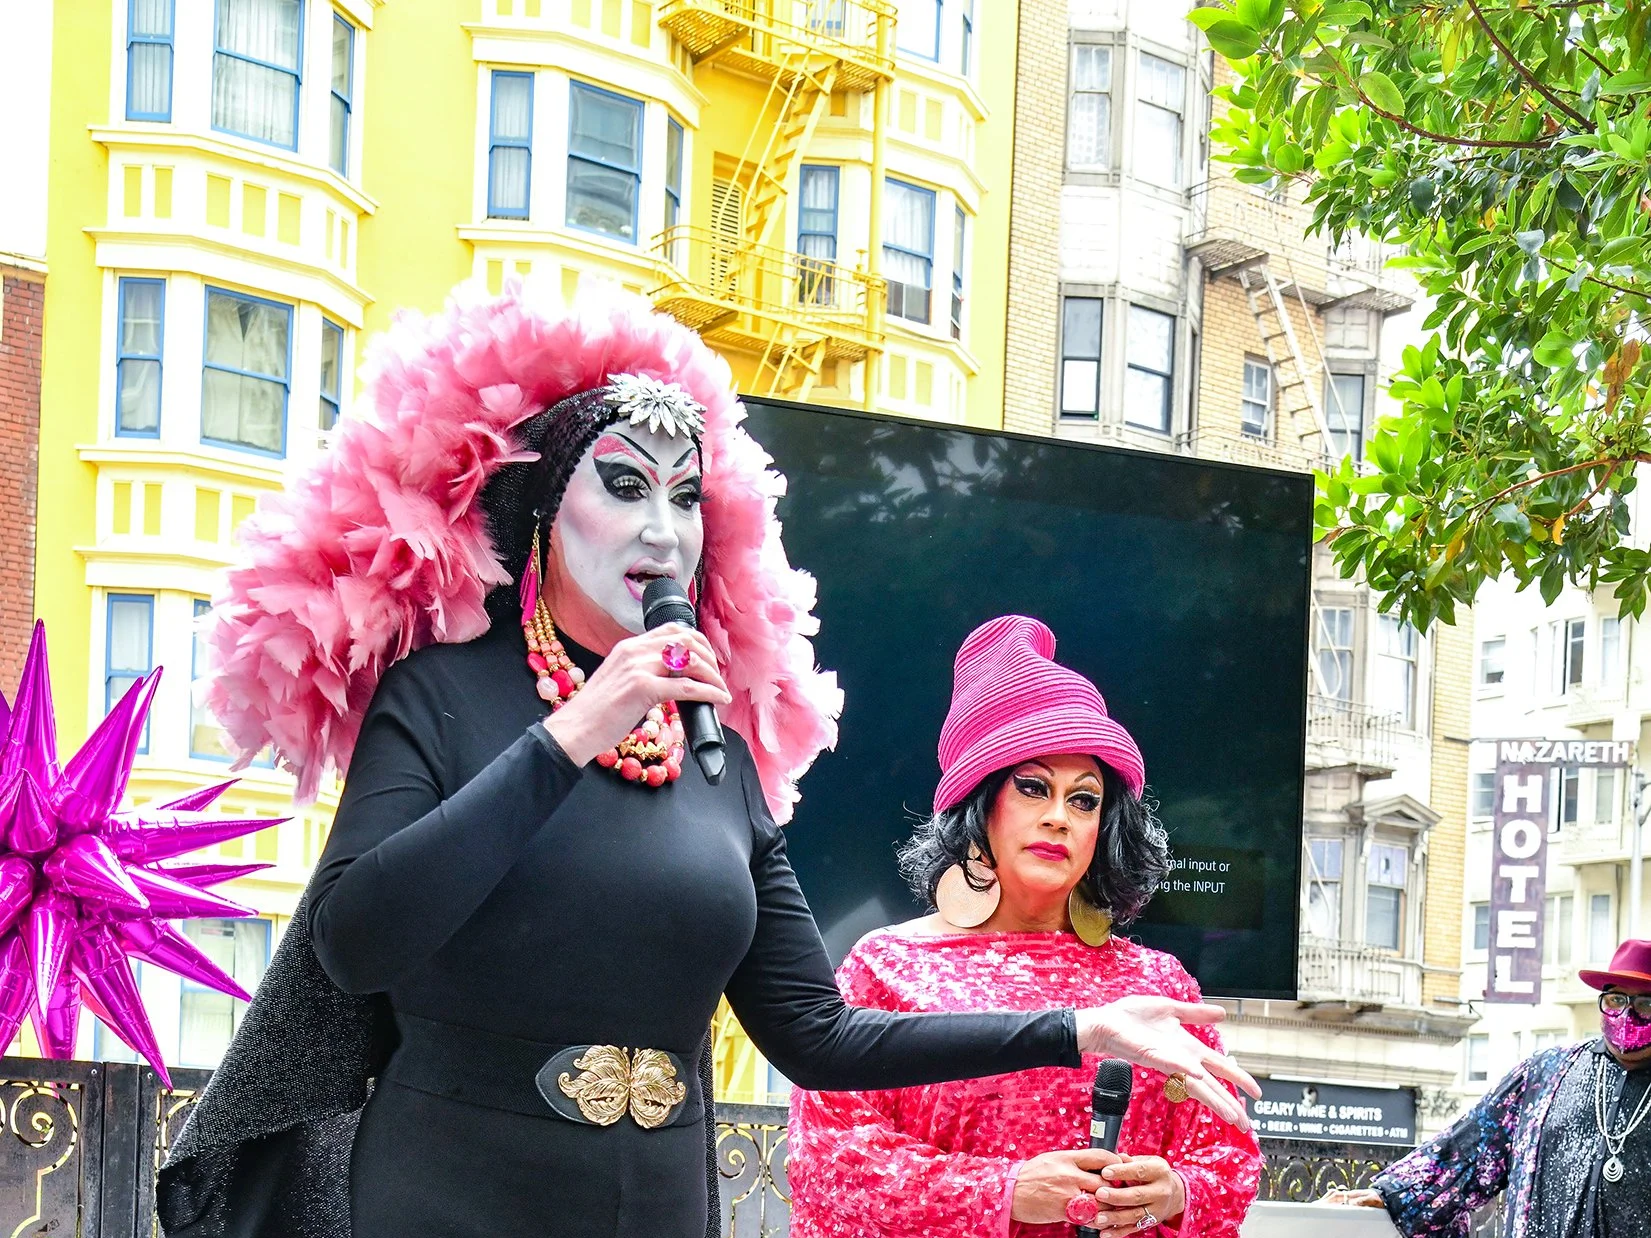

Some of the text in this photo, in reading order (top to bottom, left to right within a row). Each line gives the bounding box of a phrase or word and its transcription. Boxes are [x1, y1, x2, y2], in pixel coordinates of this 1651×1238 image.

[1500, 741, 1630, 763] NAZARETH
[1188, 858, 1216, 872] input
[1219, 862, 1231, 872] or
[1173, 880, 1190, 891] the
[1193, 881, 1225, 894] INPUT
[1494, 774, 1543, 994] HOTEL
[1254, 1100, 1382, 1121] GEARY WINE & SPIRITS
[1267, 1120, 1293, 1132] BEER
[1299, 1122, 1323, 1134] WINE
[1328, 1122, 1383, 1137] CIGARETTES
[1389, 1126, 1408, 1139] ATM
